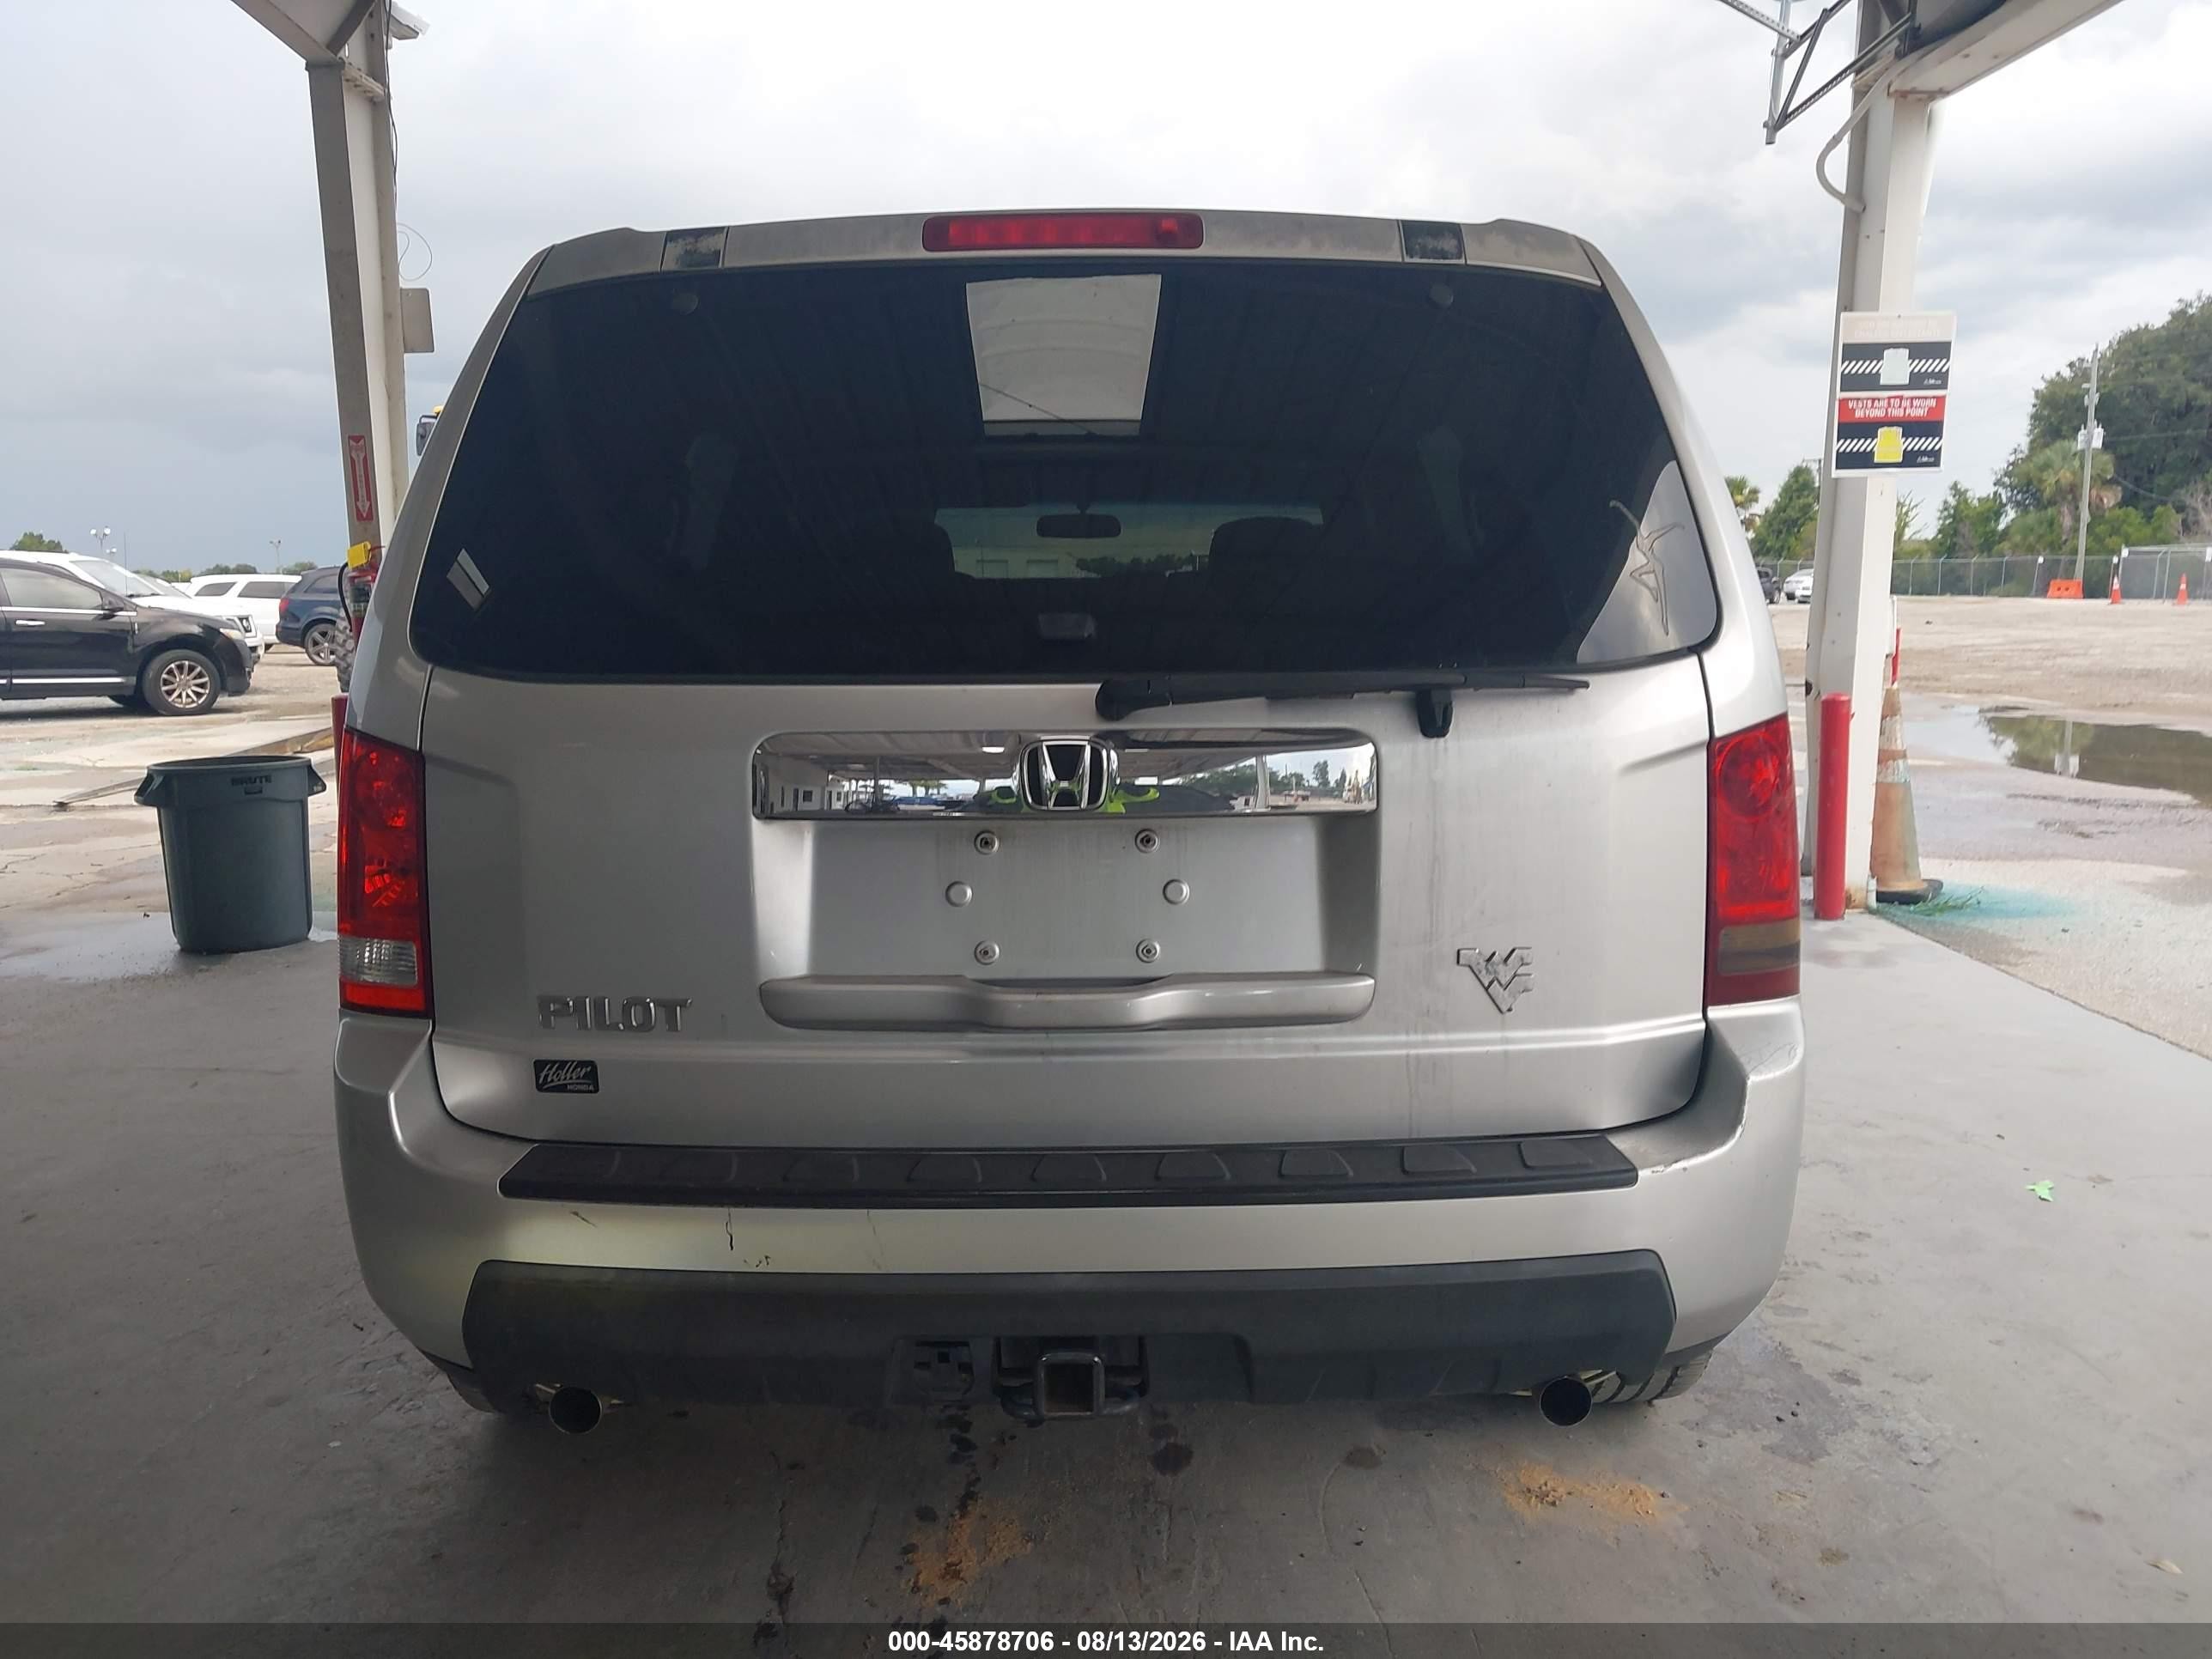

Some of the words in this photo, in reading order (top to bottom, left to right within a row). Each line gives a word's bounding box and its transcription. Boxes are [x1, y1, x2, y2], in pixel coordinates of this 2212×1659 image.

[1890, 398, 1900, 408] TO
[1912, 398, 1936, 408] WORN
[1855, 408, 1886, 418] BEYOND
[1887, 407, 1905, 417] THIS
[1905, 406, 1929, 417] POINT
[231, 775, 271, 786] BRUTE
[538, 995, 693, 1032] PILOT
[539, 1061, 592, 1084] Holler
